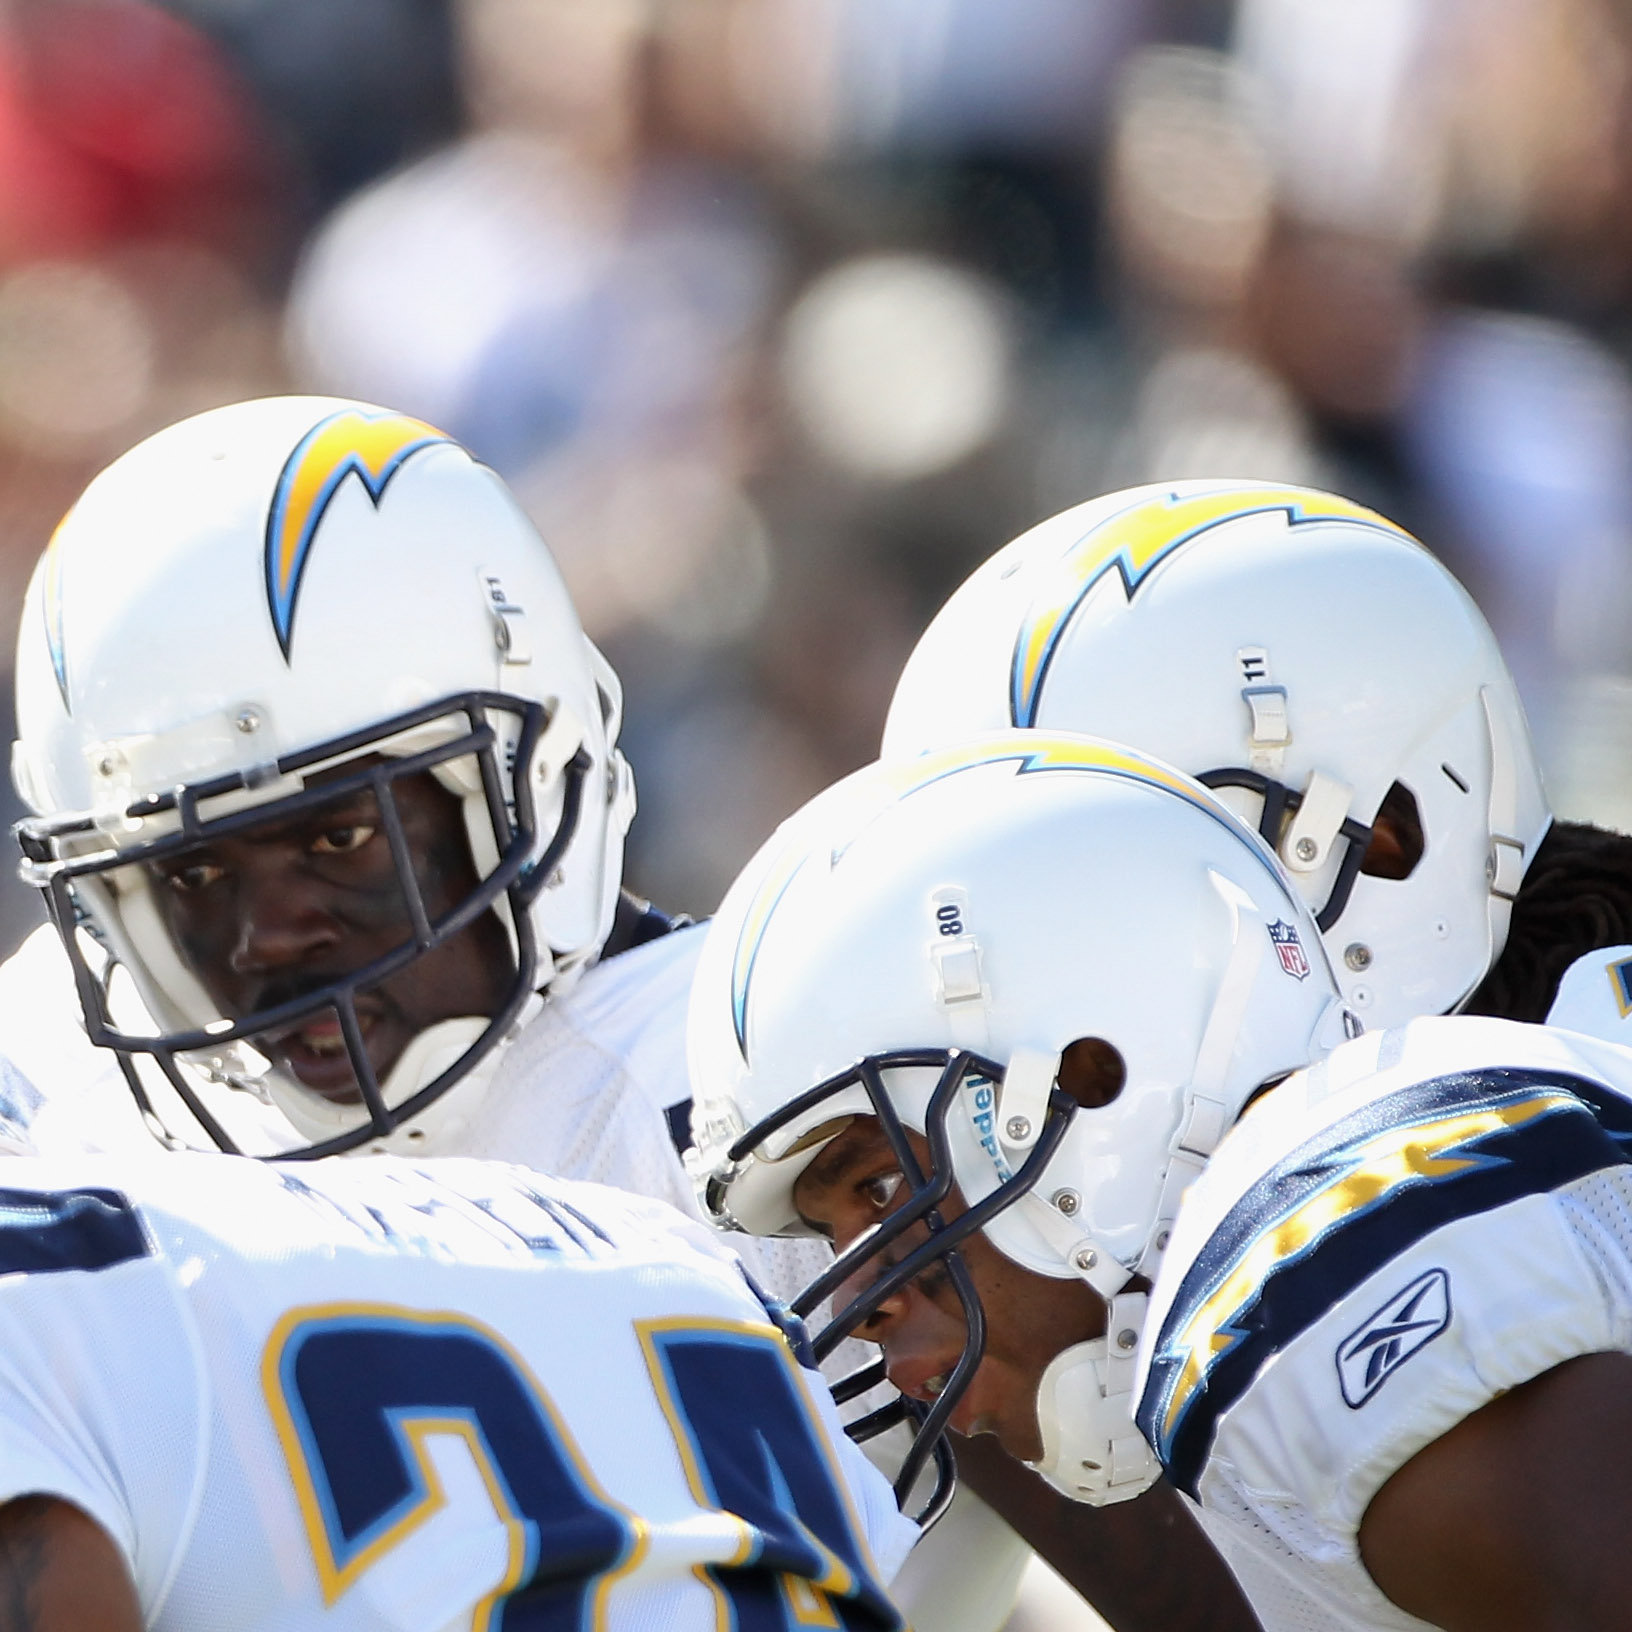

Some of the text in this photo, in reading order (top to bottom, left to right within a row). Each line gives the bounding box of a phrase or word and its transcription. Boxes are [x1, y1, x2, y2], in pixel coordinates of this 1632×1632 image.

[1241, 657, 1266, 682] 11
[937, 904, 964, 936] 80
[1277, 944, 1309, 975] NFL
